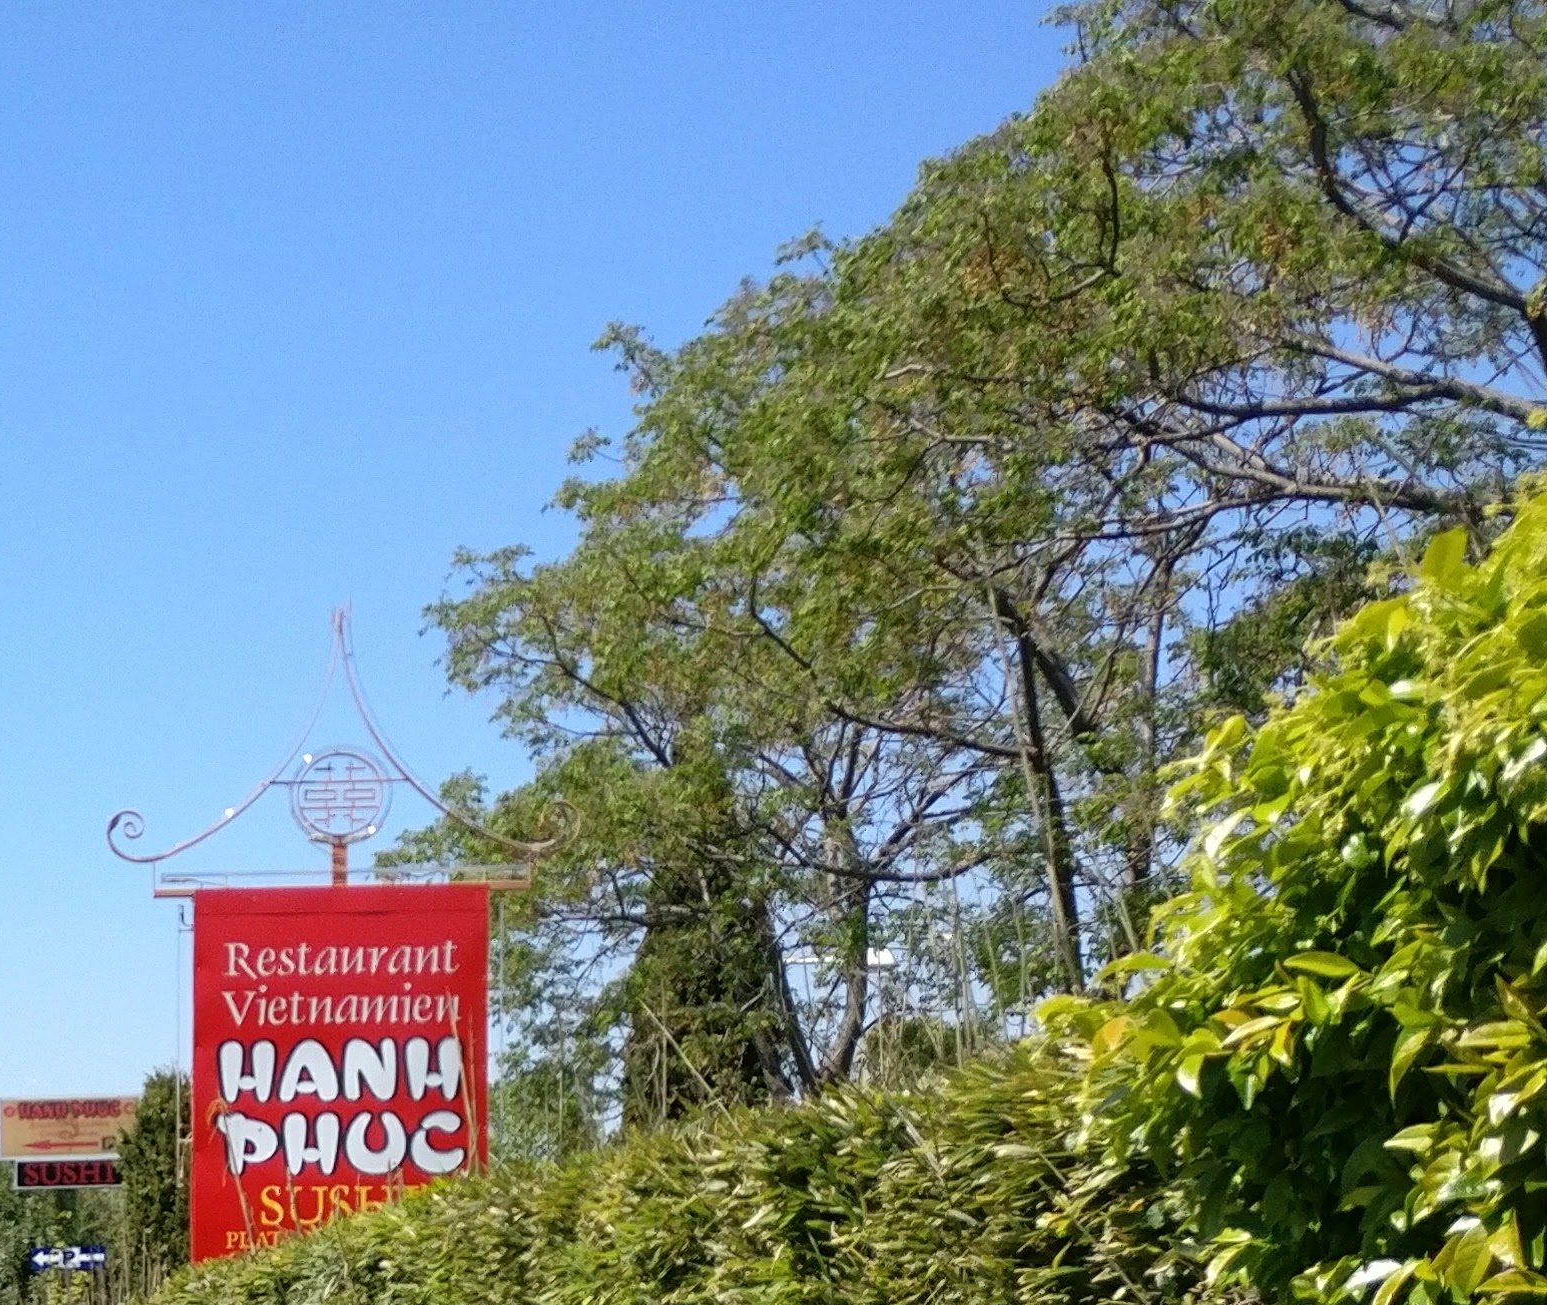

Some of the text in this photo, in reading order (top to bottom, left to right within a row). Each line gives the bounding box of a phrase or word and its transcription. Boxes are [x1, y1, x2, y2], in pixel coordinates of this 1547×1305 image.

[223, 940, 460, 980] Restaurant
[221, 982, 462, 1027] Vietnamien
[217, 1036, 463, 1103] HANH
[215, 1110, 466, 1176] PHUC
[23, 1161, 115, 1185] SUSHI
[259, 1184, 428, 1227] SUSH
